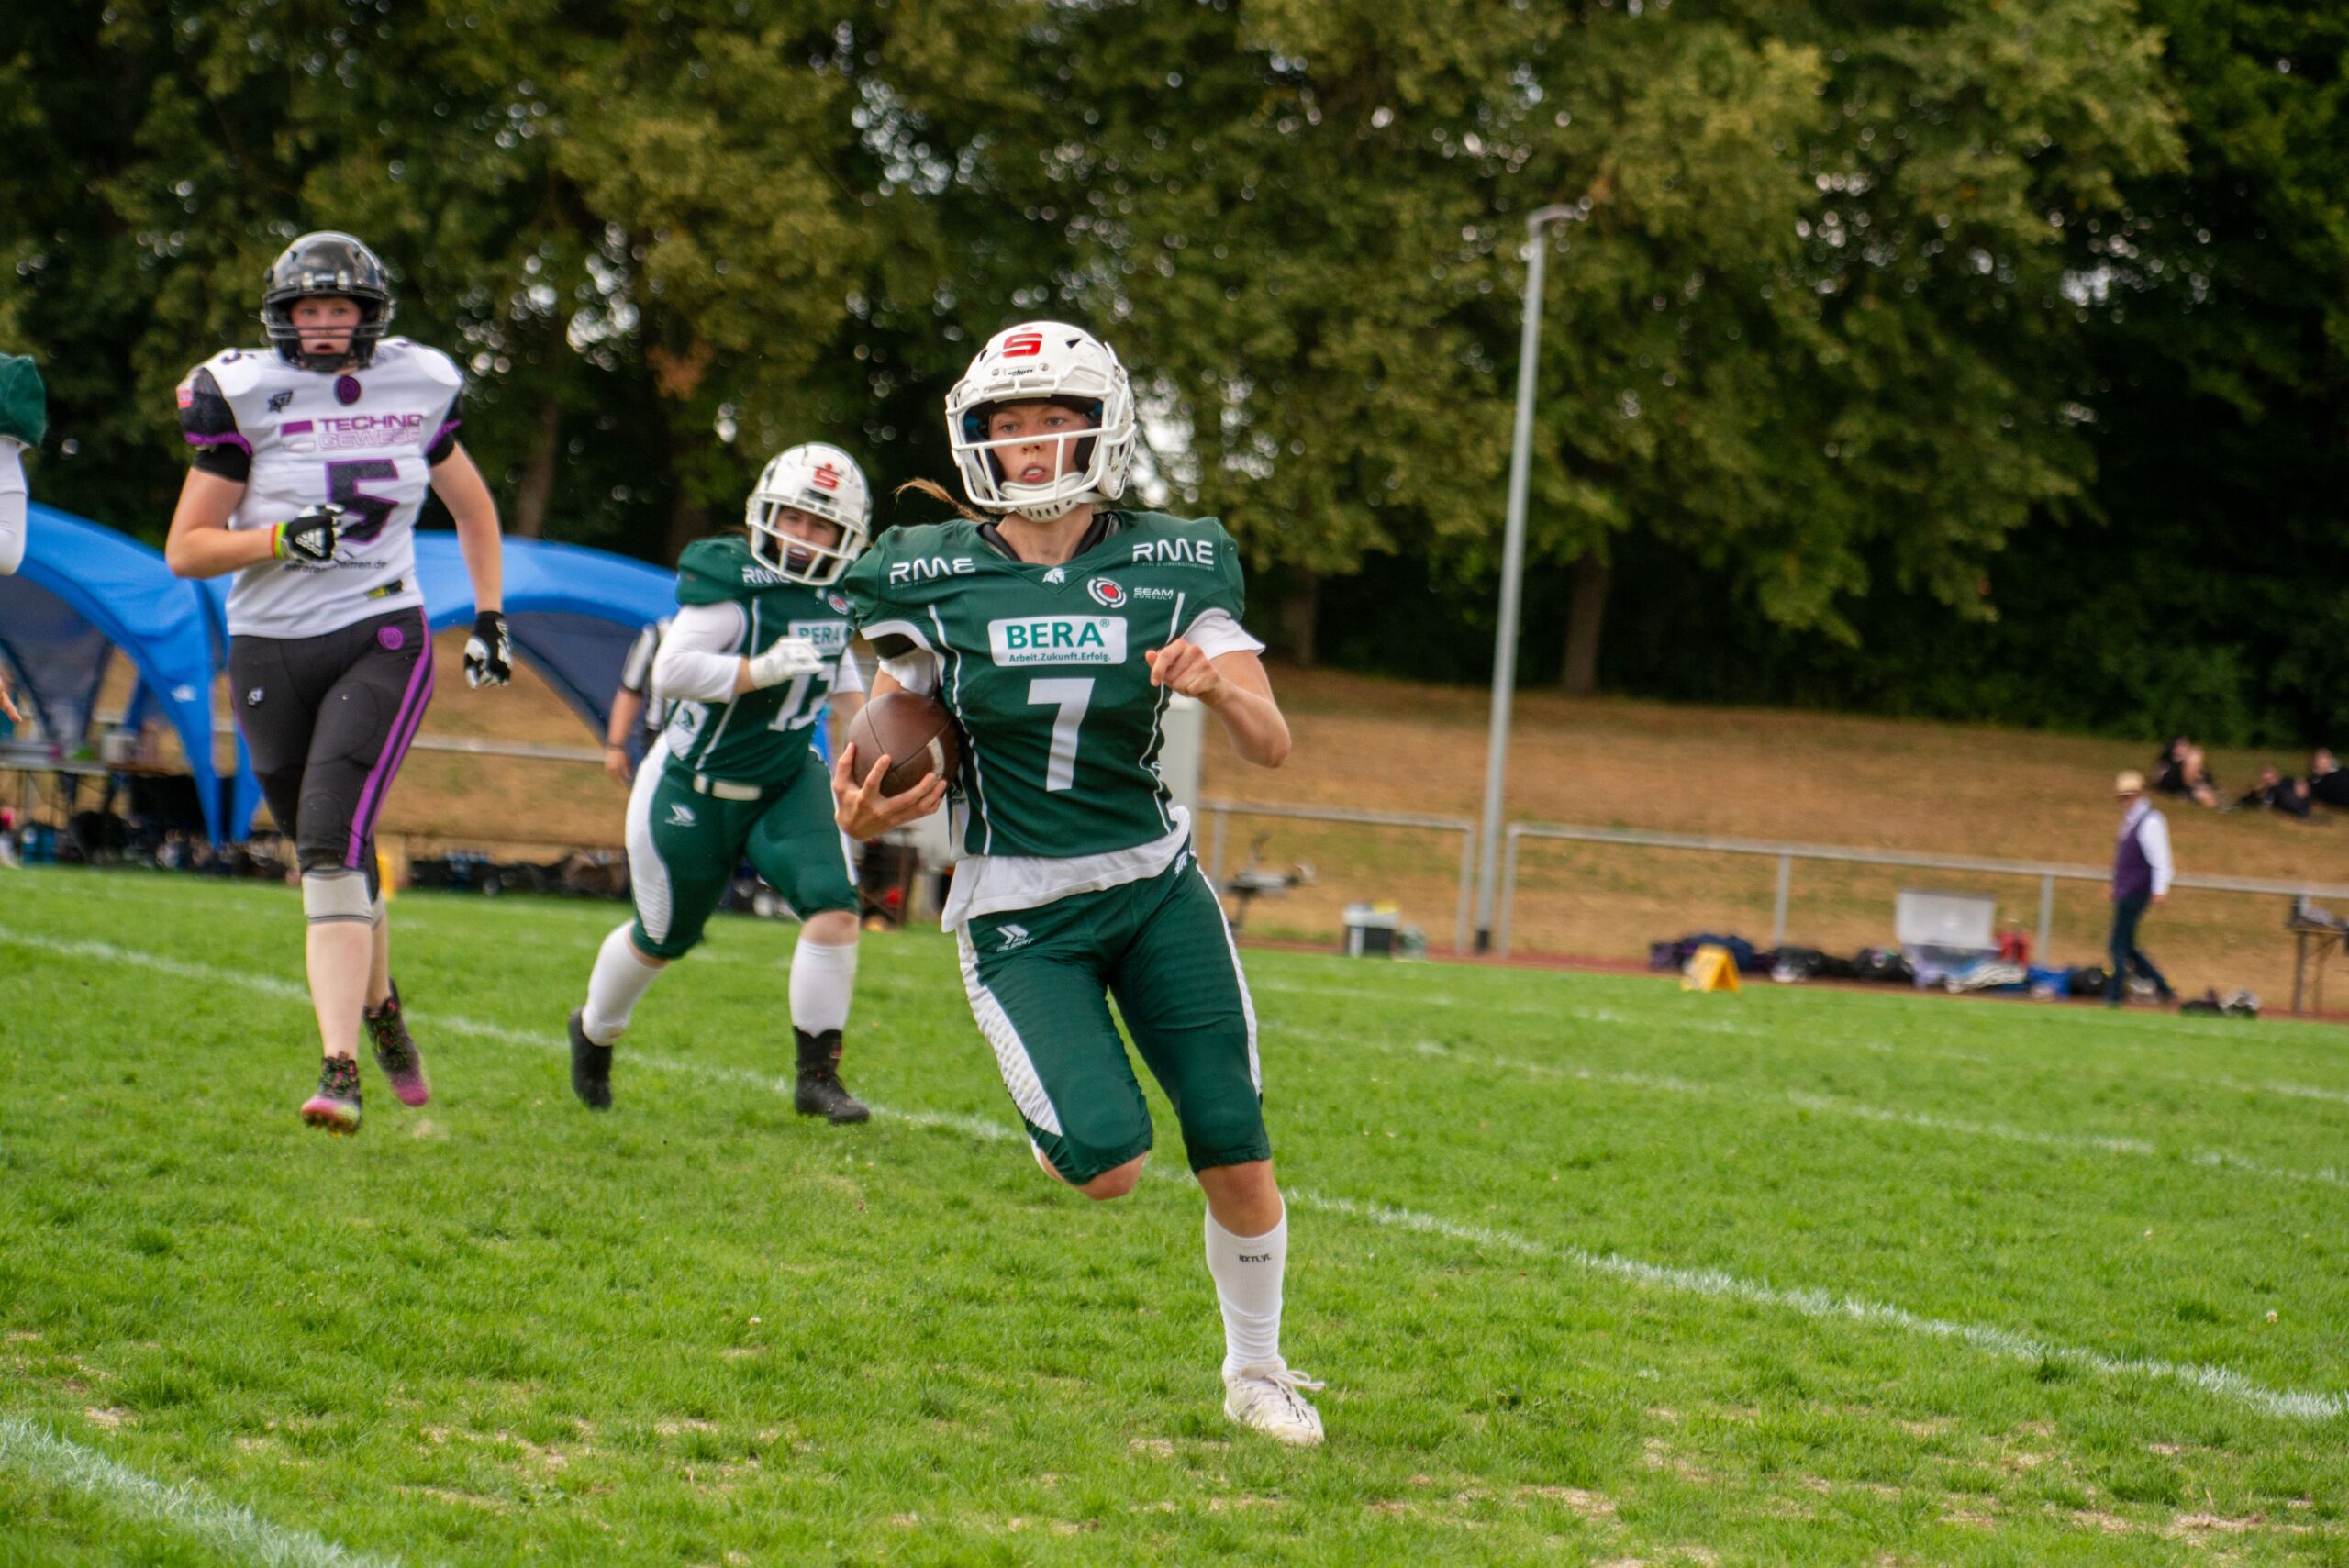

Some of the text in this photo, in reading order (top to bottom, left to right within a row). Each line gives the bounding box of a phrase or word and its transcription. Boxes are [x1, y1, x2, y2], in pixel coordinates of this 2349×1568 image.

[318, 414, 423, 432] TECHNO
[325, 458, 400, 546] 5
[1132, 538, 1214, 565] RME
[889, 556, 976, 584] RME
[1133, 587, 1174, 596] SEAM
[1009, 651, 1111, 662] Arbeit.Zukunft.Erfolg.
[1027, 678, 1095, 792] 7
